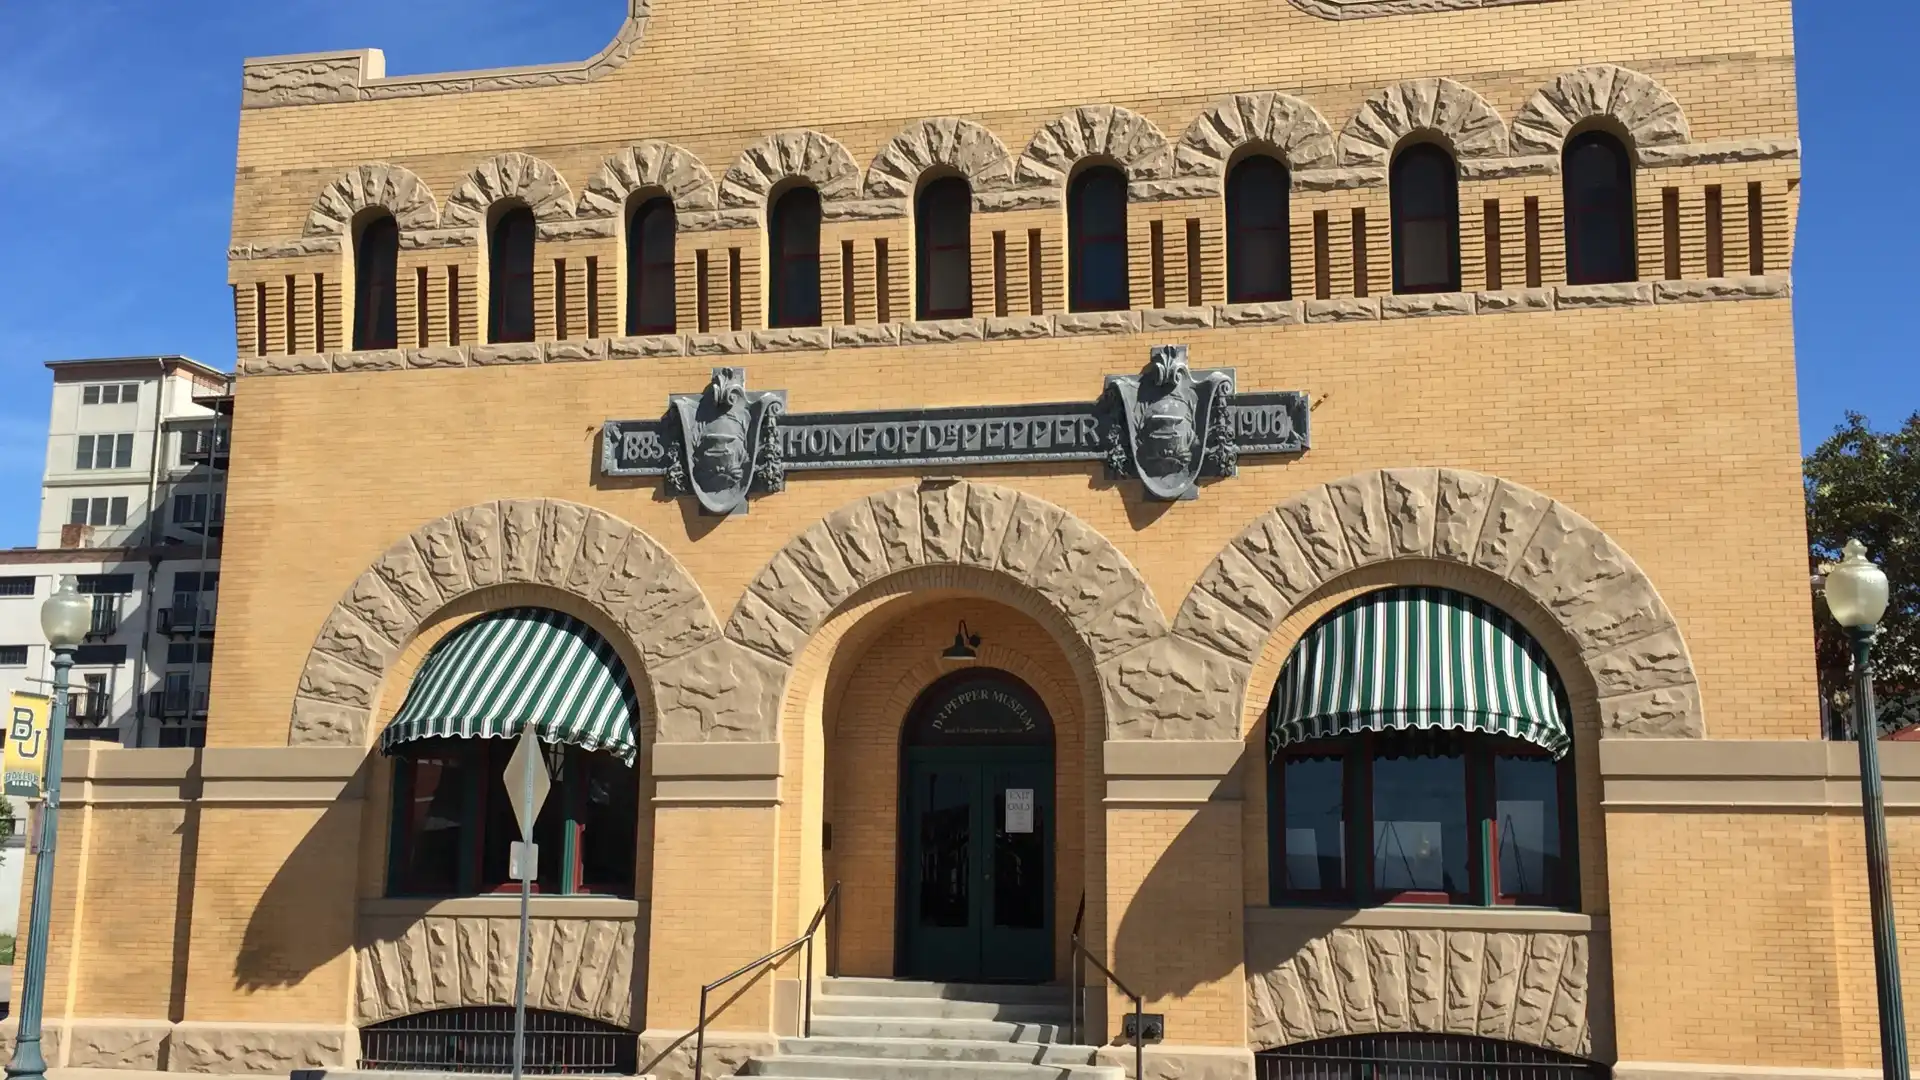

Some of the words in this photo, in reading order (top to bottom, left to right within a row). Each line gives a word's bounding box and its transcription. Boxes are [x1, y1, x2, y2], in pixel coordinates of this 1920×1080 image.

[623, 433, 665, 460] 1885
[786, 425, 877, 456] HOME
[880, 421, 923, 453] OF
[961, 415, 1100, 450] PEPPER
[1237, 407, 1286, 436] 1906
[944, 689, 989, 714] PEPPER
[992, 690, 1036, 730] MUSEUM
